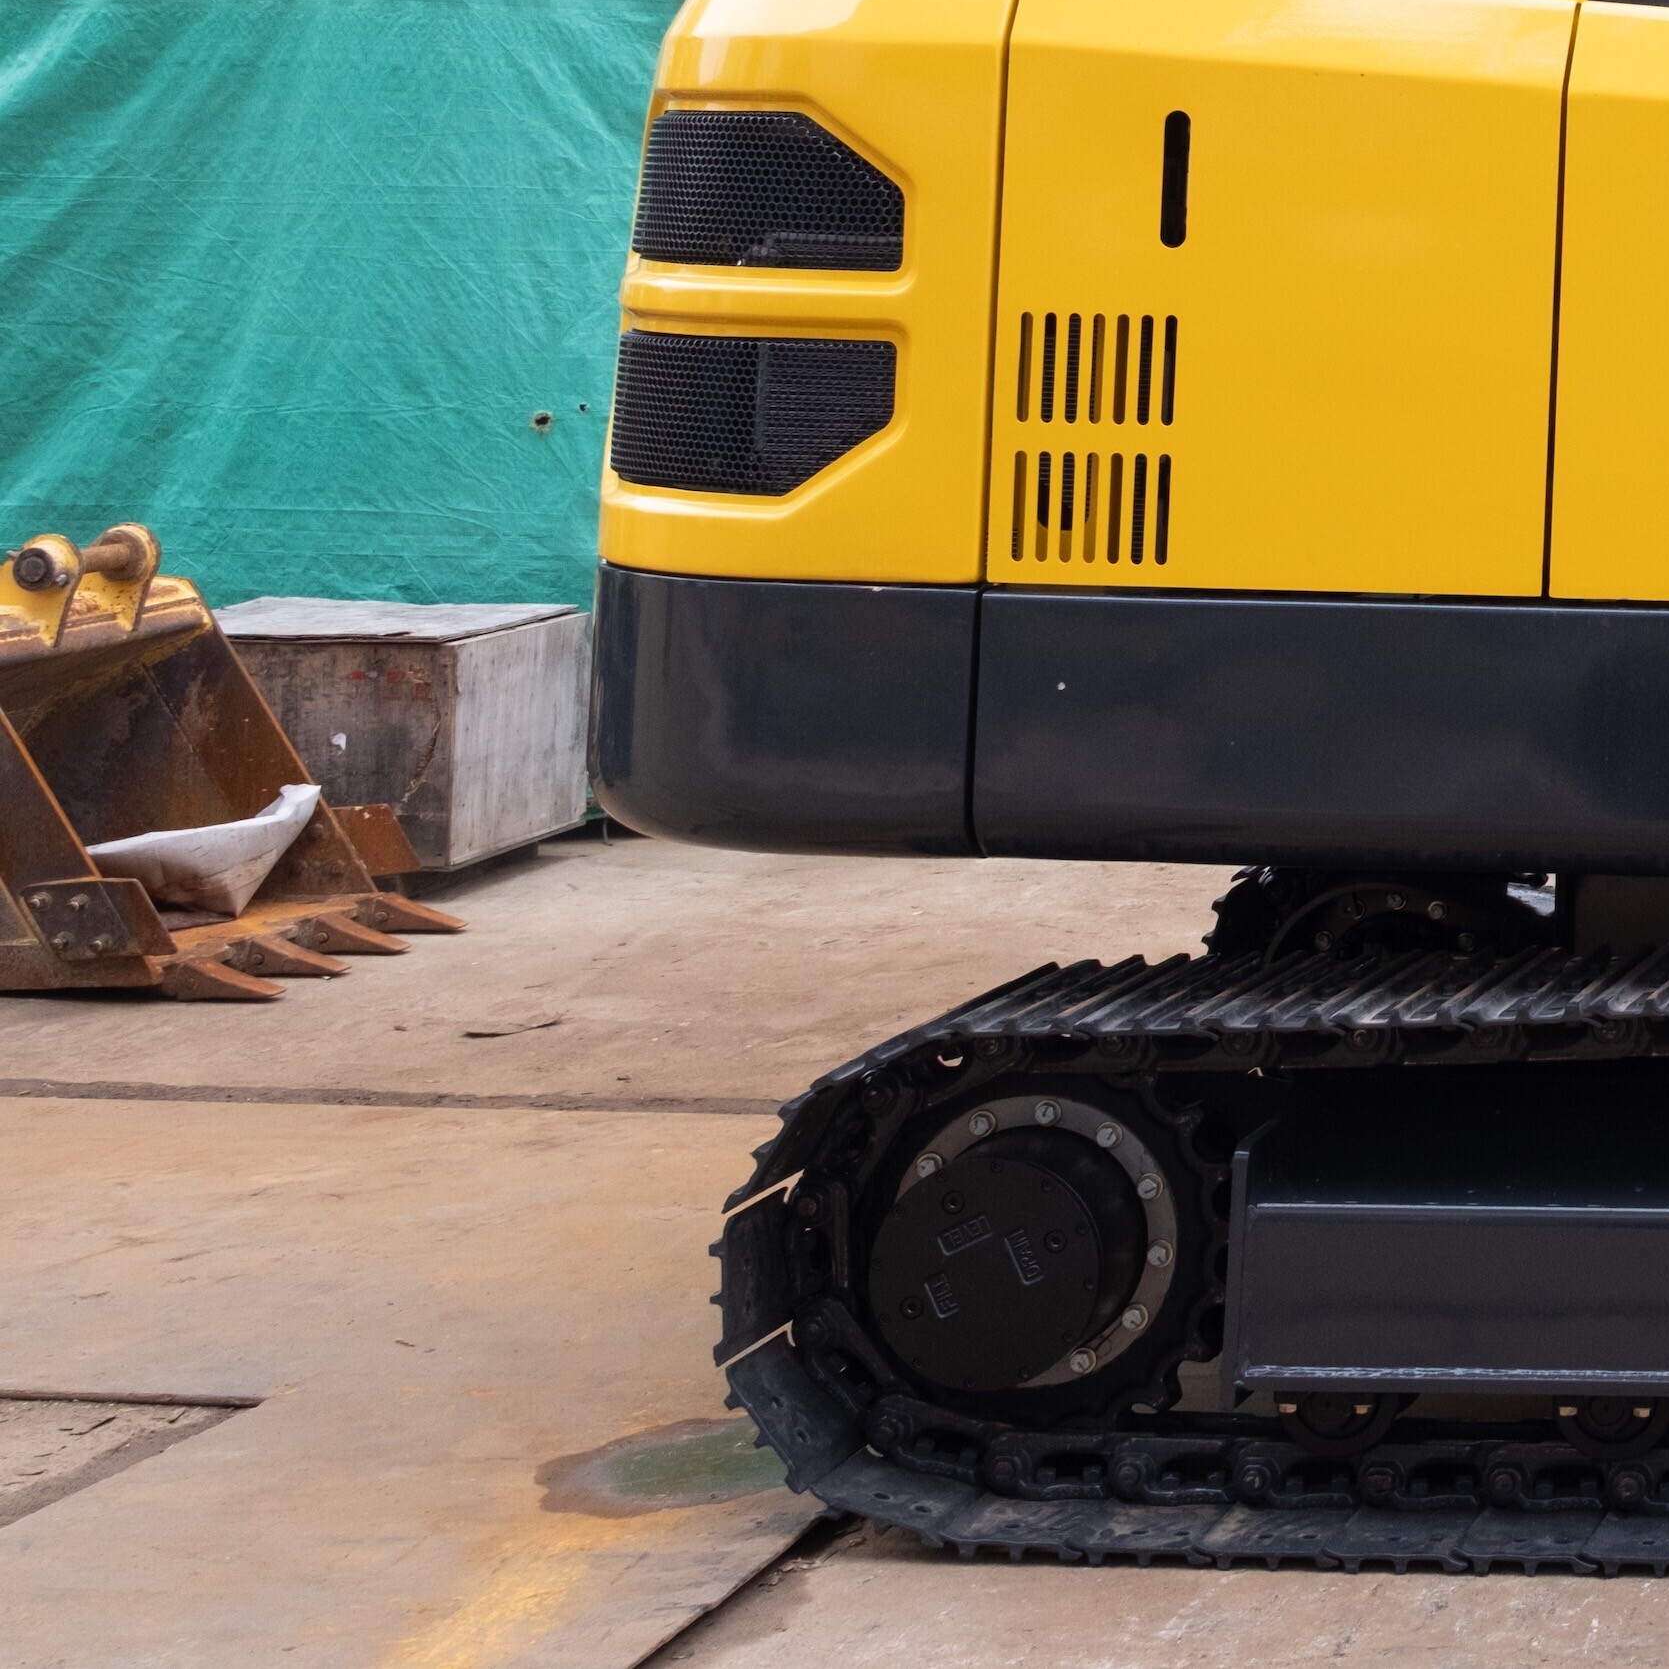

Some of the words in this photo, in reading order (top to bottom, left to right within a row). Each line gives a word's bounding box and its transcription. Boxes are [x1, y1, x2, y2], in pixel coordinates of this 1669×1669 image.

[943, 1215, 990, 1246] LEVEL
[1009, 1229, 1040, 1278] DRAIN
[933, 1273, 958, 1311] FILL
